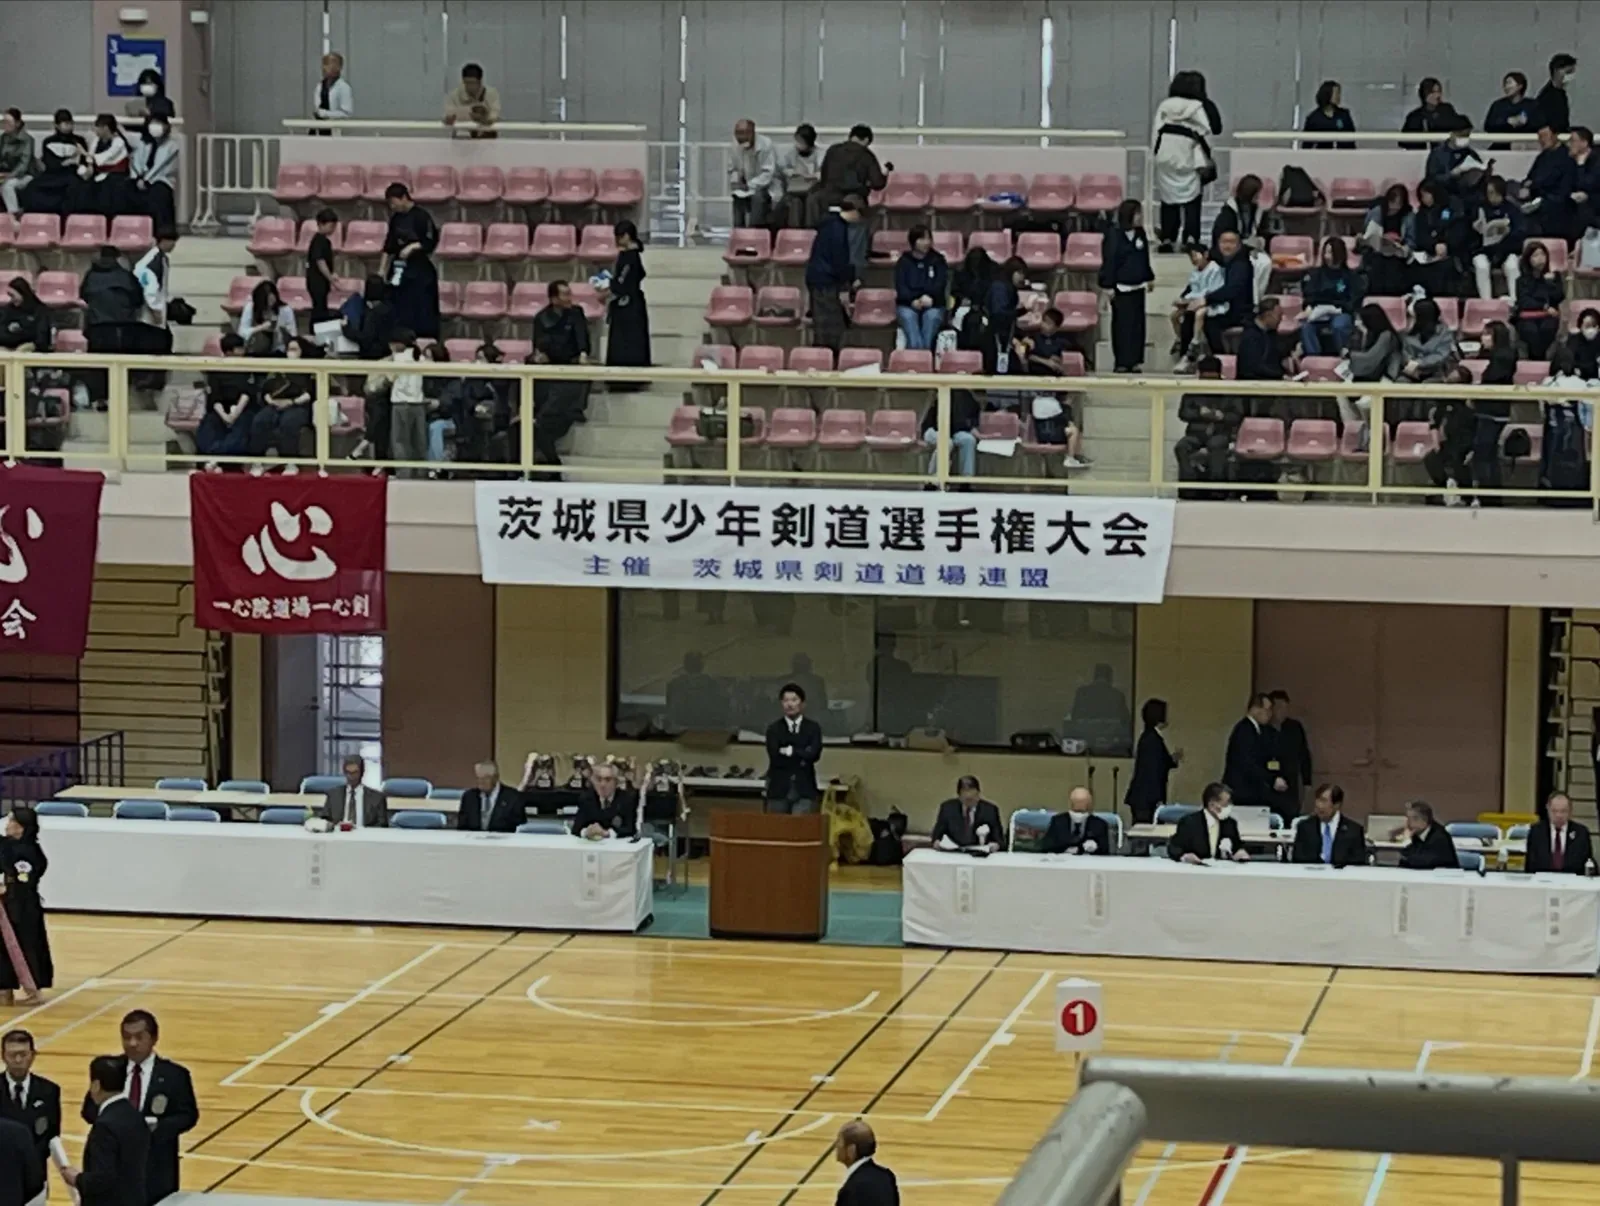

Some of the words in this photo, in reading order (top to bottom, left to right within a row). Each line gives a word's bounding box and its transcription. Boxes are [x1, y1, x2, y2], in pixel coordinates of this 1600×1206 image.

[242, 501, 337, 581] 心
[498, 495, 1149, 558] 茨城県少年剣道選手権大会
[583, 554, 651, 577] 主催
[692, 557, 1049, 589] 茨城県剣道道場連盟
